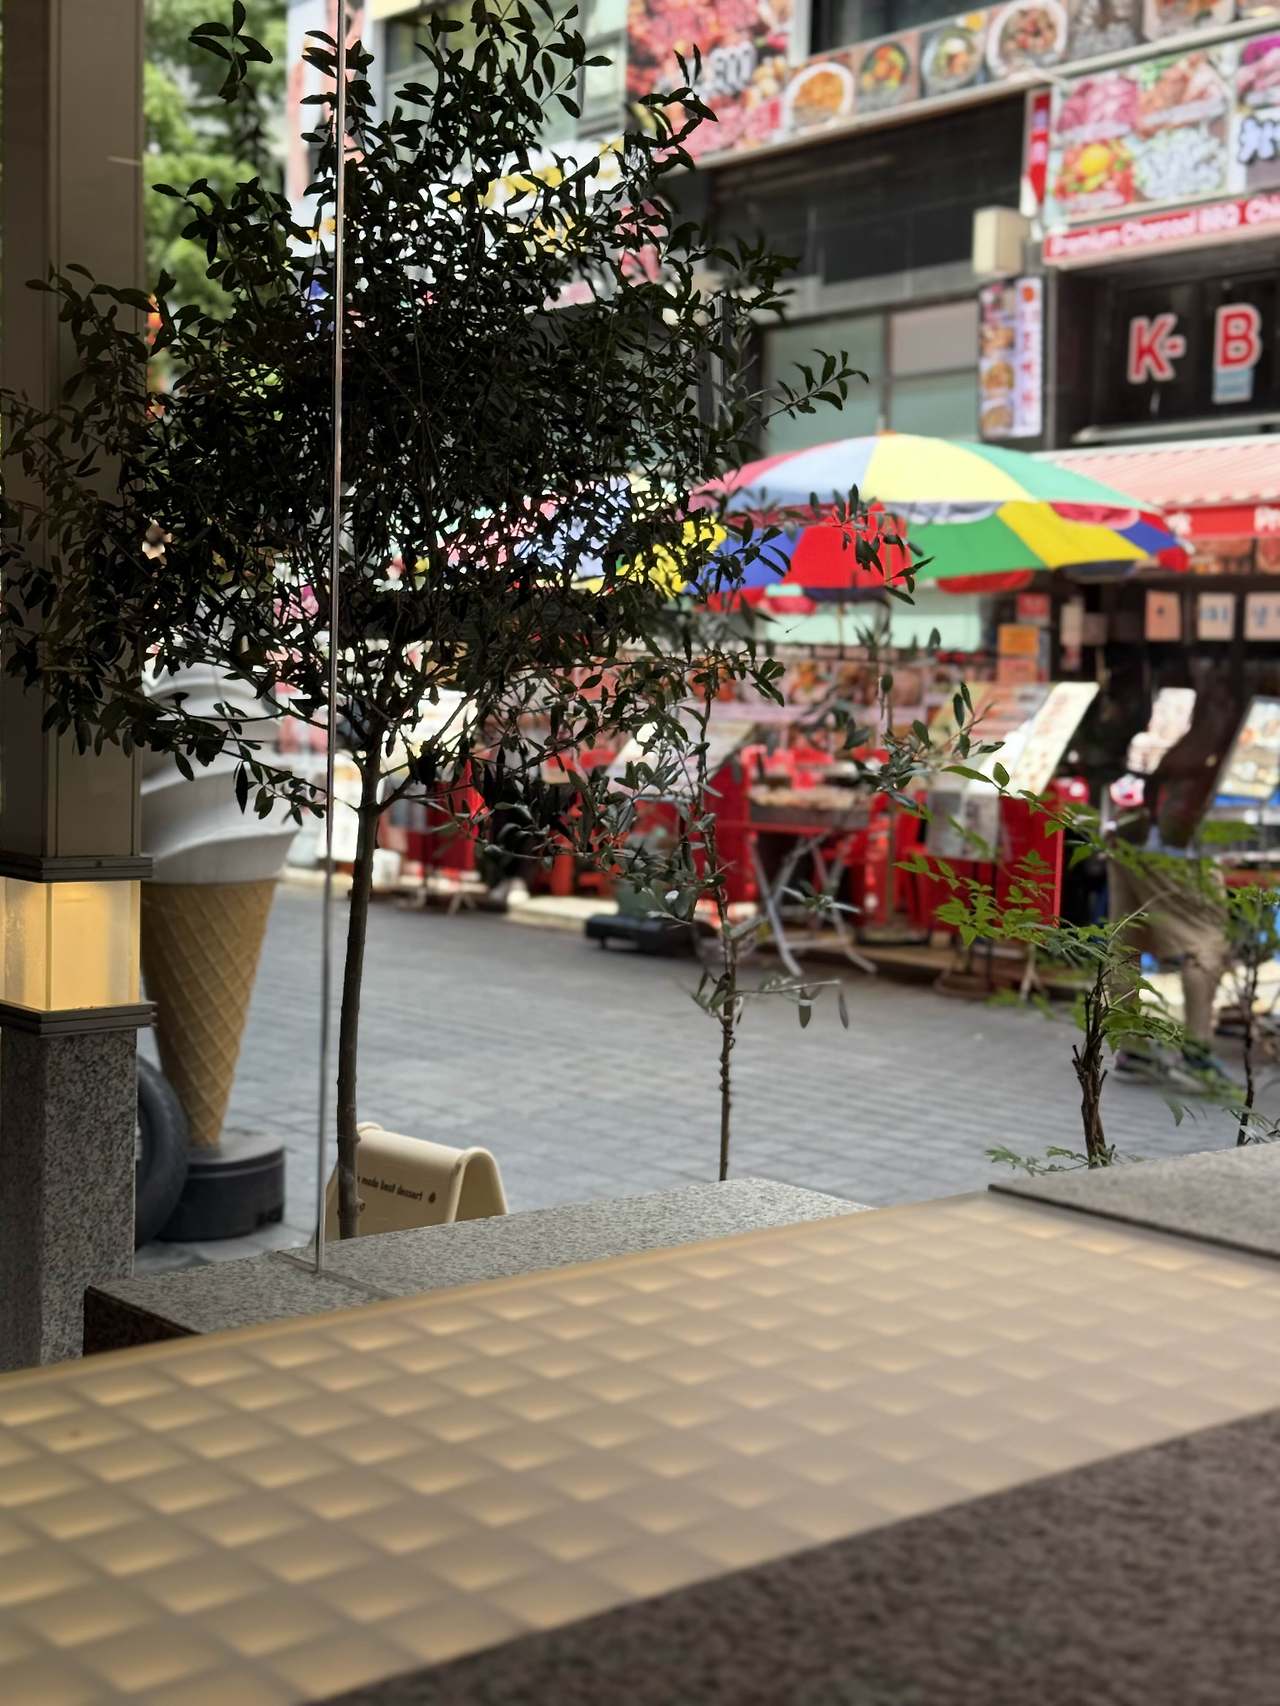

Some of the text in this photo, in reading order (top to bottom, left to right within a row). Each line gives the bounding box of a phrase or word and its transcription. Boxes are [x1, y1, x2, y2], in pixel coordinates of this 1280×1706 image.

[1213, 303, 1263, 373] B
[380, 1180, 396, 1194] best
[397, 1185, 423, 1201] dessert
